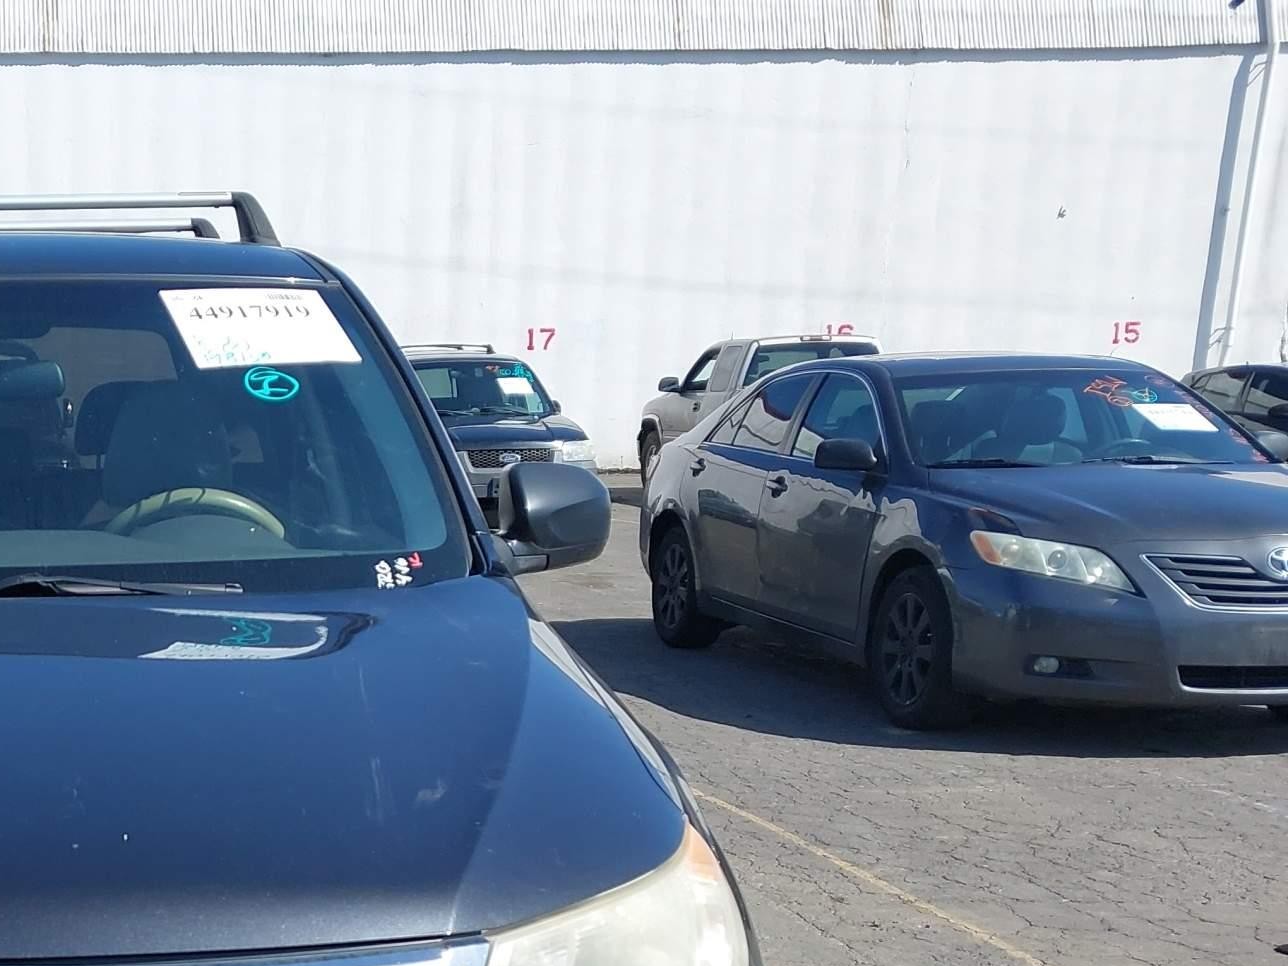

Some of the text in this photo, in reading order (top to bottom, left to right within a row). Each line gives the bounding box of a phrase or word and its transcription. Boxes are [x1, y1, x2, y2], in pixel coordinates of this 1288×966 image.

[189, 304, 311, 320] 44917919
[526, 328, 556, 351] 17
[1111, 321, 1142, 345] 15
